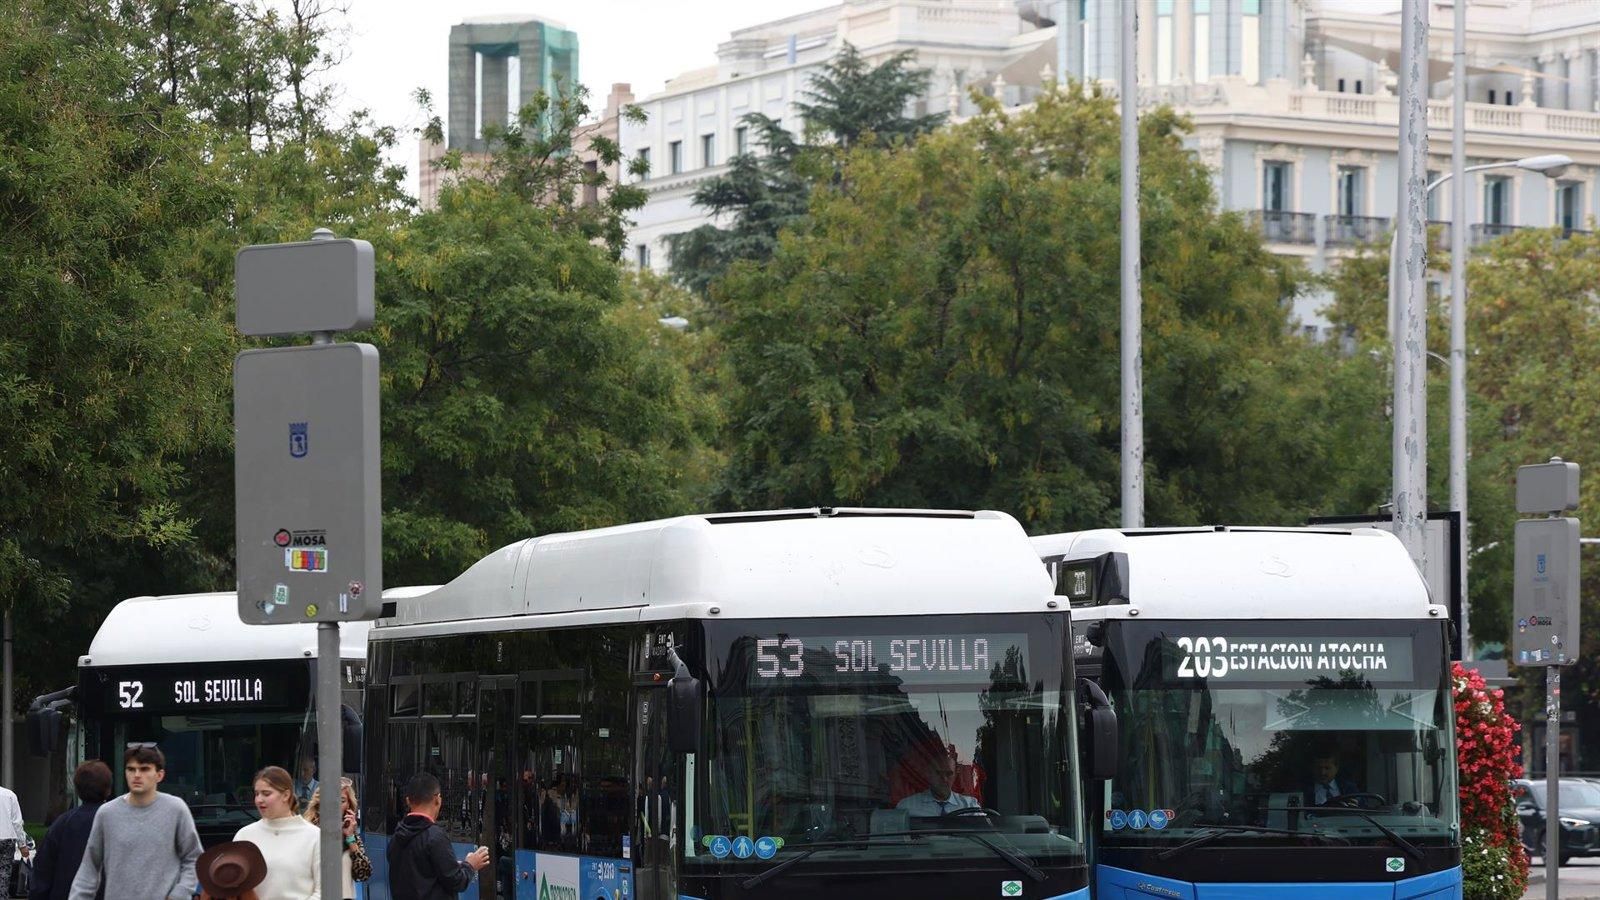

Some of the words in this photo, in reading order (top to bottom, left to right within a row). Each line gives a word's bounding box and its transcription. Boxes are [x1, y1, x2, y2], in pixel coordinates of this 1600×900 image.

[293, 536, 327, 546] MOSA
[1074, 571, 1087, 595] 203
[757, 639, 804, 677] 53
[835, 640, 879, 672] SOL
[890, 639, 989, 671] SEVILLA
[1177, 637, 1229, 678] 203
[1230, 643, 1313, 670] ESTACION
[1317, 643, 1388, 670] ATOCHA
[119, 681, 144, 708] 52
[174, 681, 200, 703] SOL
[204, 678, 263, 702] SEVILLA
[1005, 884, 1020, 892] GNC
